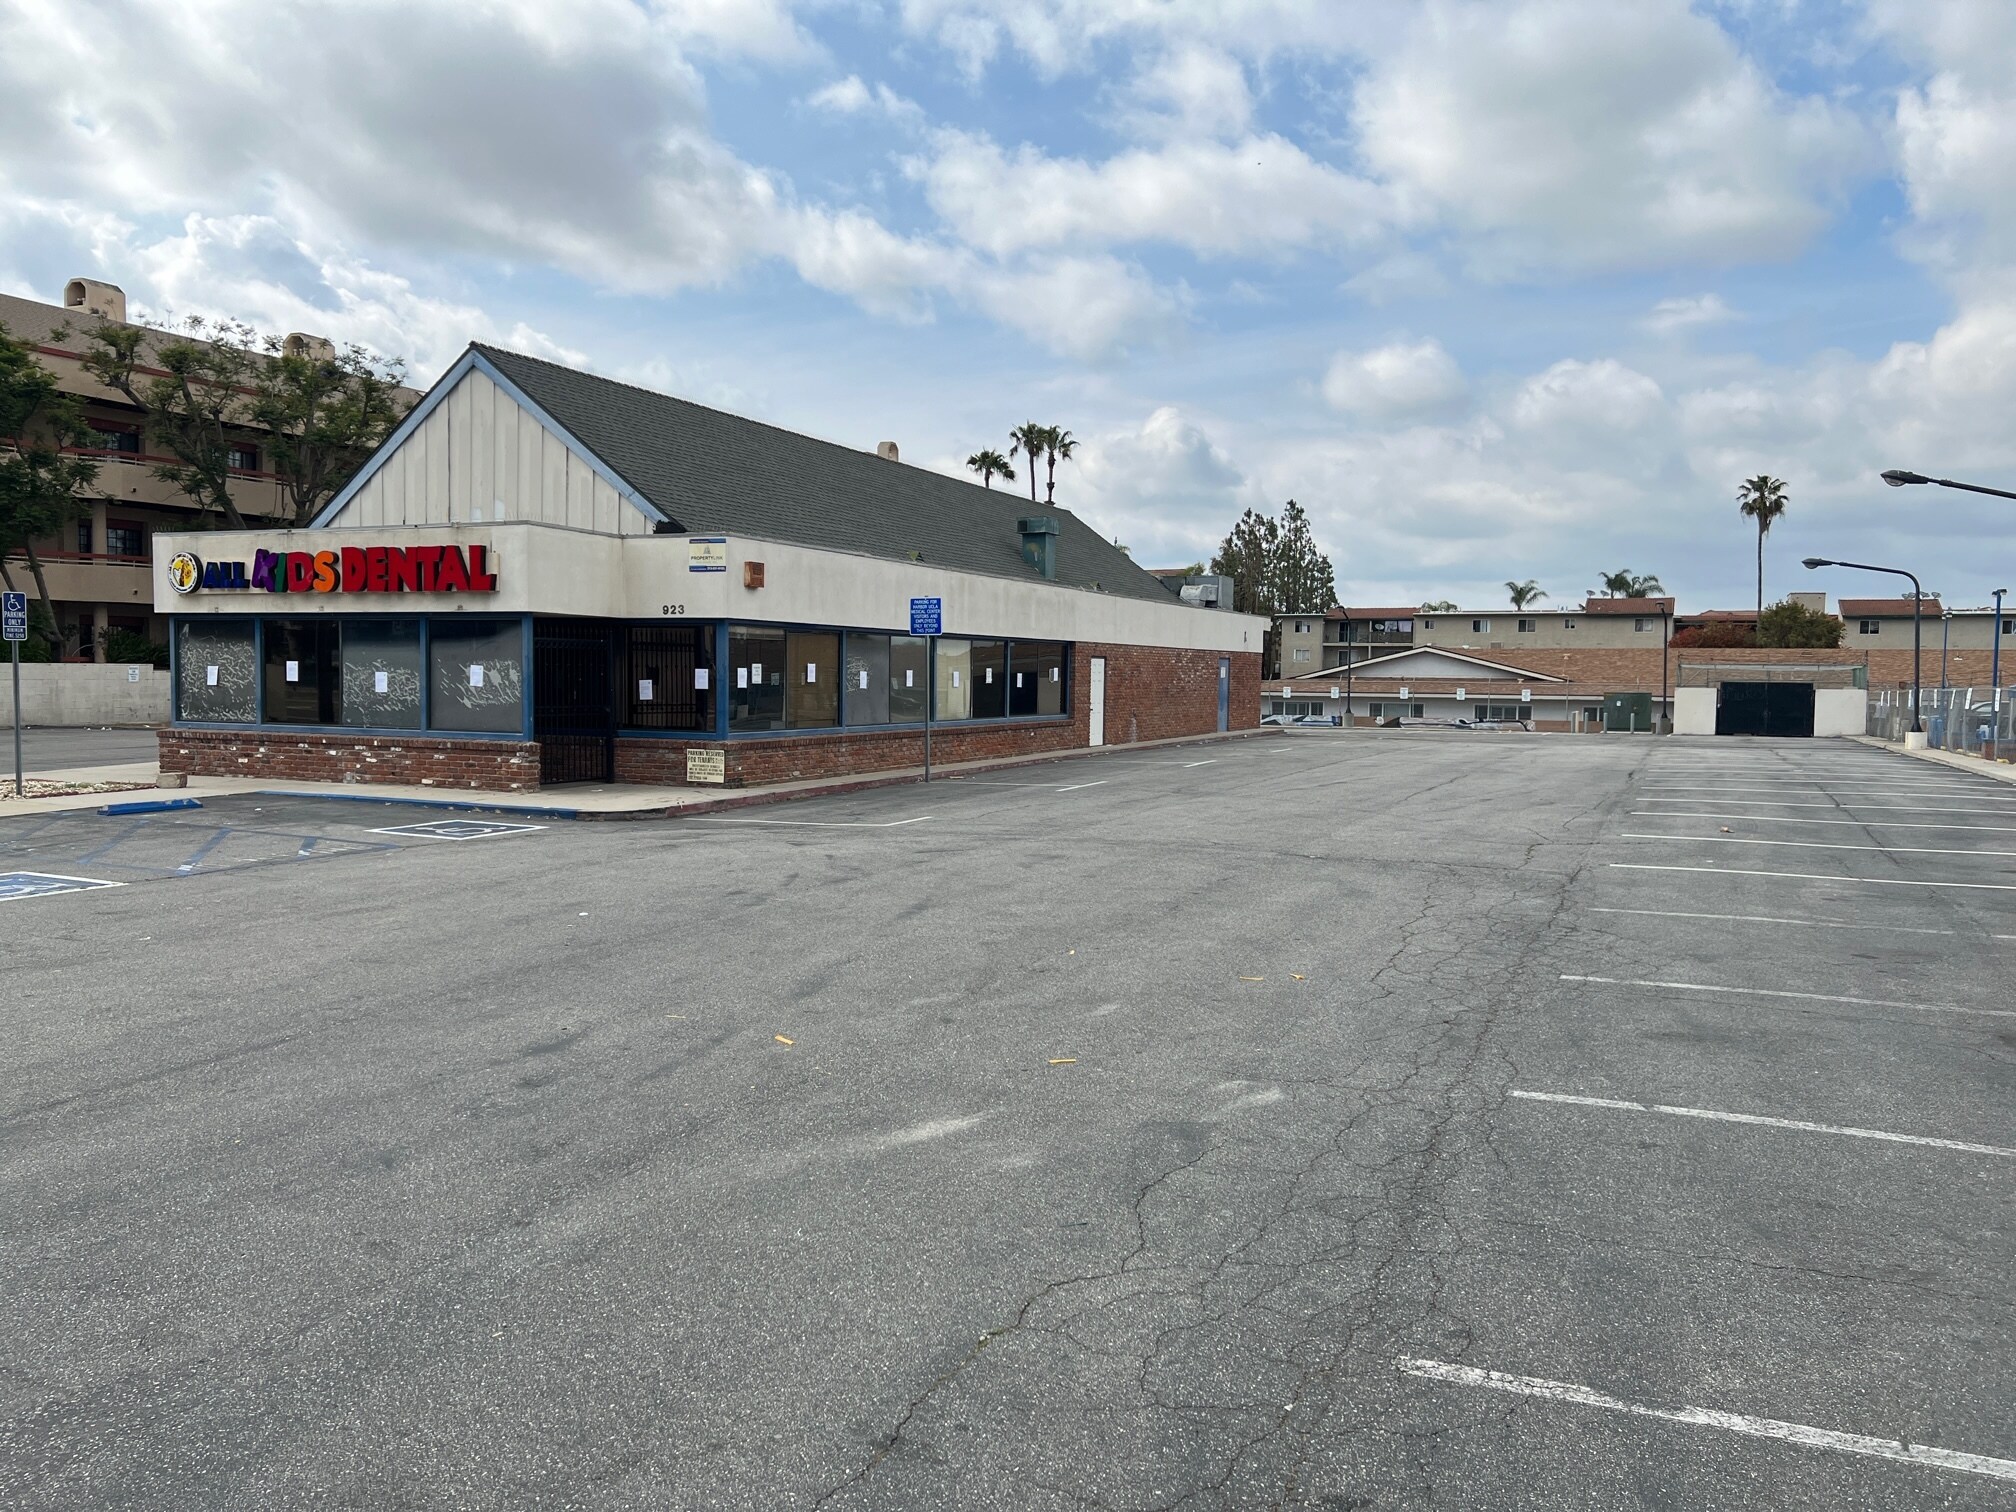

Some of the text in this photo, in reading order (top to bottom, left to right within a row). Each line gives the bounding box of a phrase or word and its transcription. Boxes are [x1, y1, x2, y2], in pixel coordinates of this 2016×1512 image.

[202, 561, 250, 589] ALL
[251, 548, 340, 593] KIDS
[341, 544, 498, 592] DENTAL
[662, 605, 685, 615] 923
